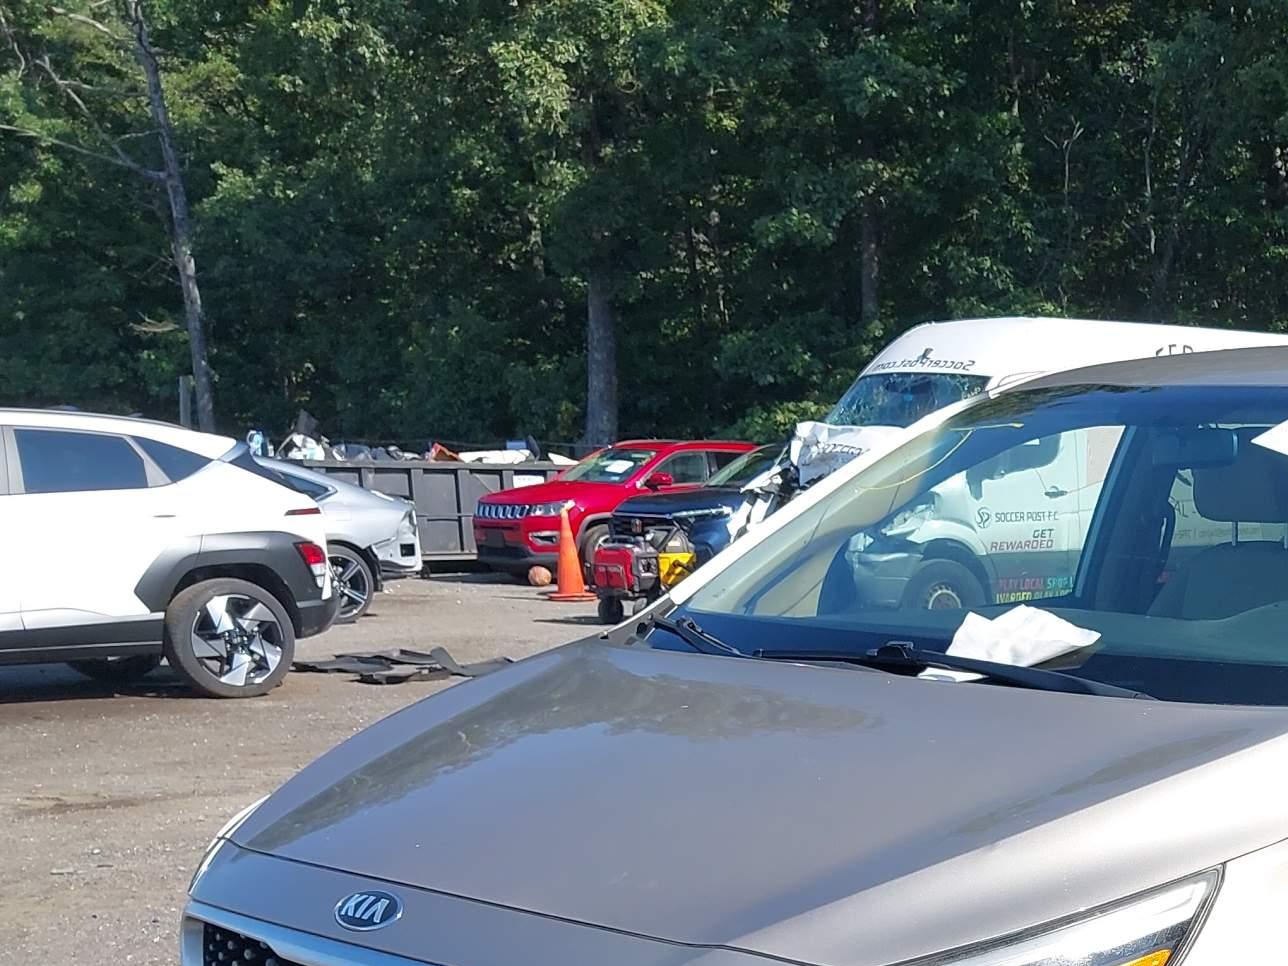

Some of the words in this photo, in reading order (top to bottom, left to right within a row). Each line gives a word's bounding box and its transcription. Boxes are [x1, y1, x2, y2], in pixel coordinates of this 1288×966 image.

[995, 511, 1025, 523] SOCCER
[1026, 511, 1045, 522] POST
[1032, 528, 1055, 539] GET
[990, 539, 1054, 552] REWARDED
[340, 893, 390, 923] KIA
